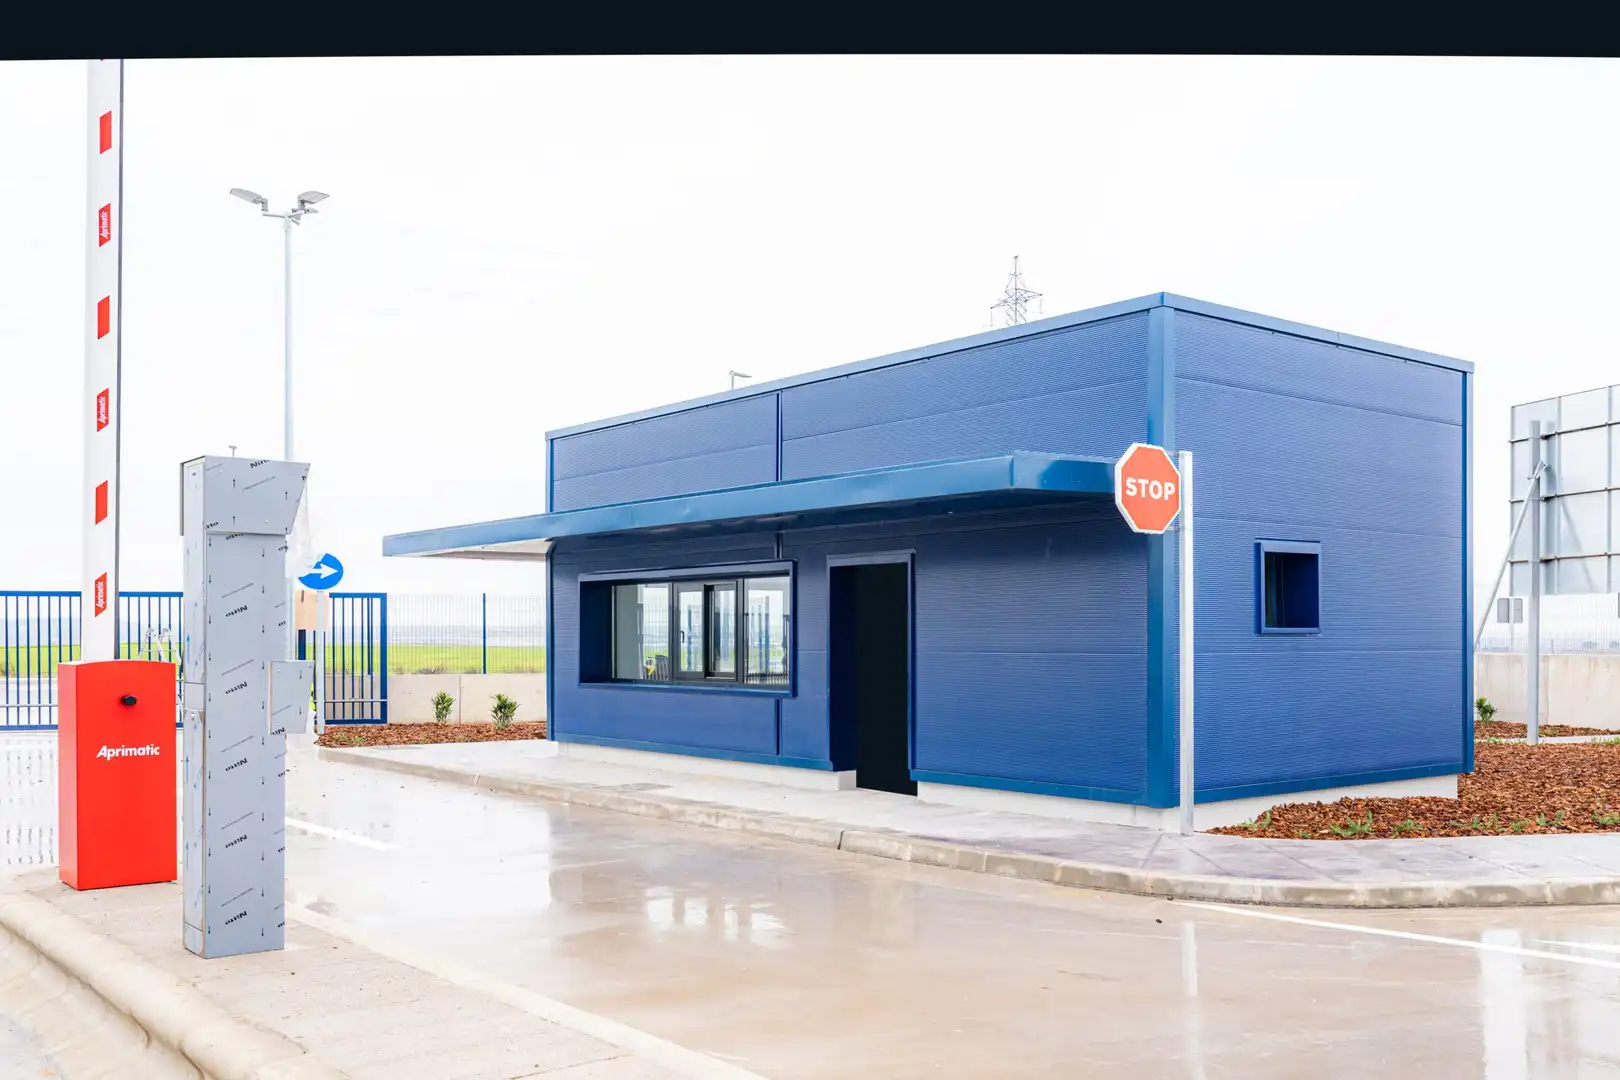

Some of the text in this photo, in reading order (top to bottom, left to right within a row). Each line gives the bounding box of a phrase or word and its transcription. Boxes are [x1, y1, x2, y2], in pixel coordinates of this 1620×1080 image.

[1125, 477, 1176, 501] STOP
[225, 605, 248, 617] Nitto
[225, 681, 247, 694] Nitto
[95, 743, 160, 761] Aprimatic
[225, 758, 248, 771] Nitto
[225, 834, 247, 848] Nitto
[224, 910, 247, 925] Nitto
